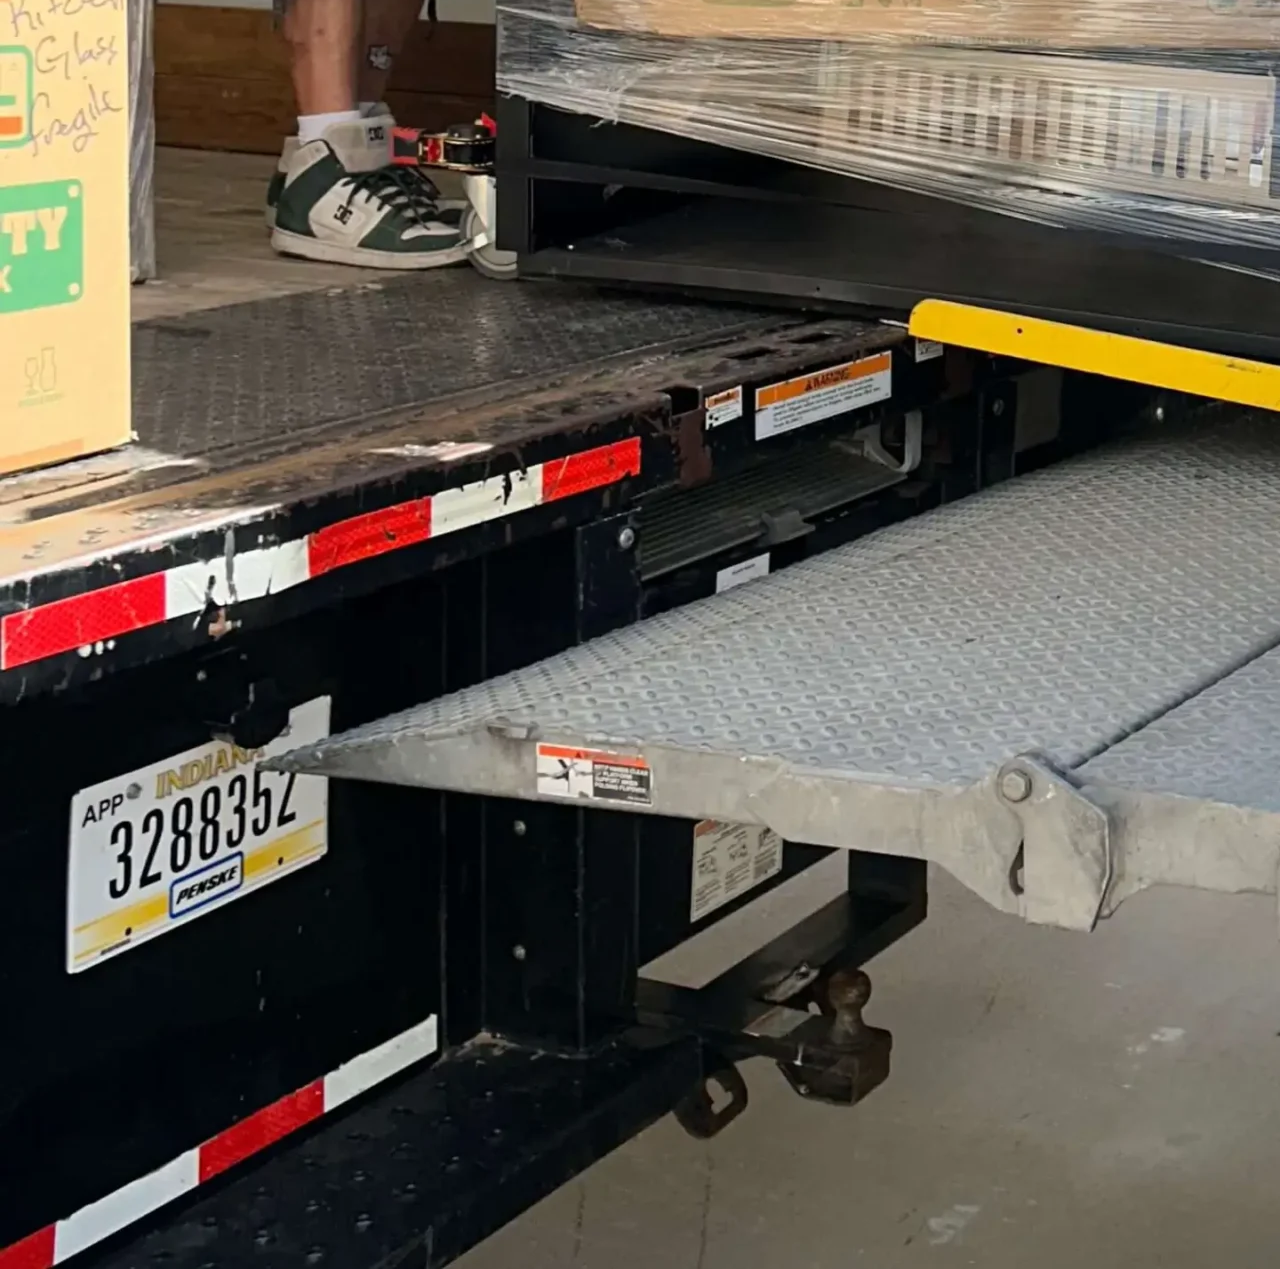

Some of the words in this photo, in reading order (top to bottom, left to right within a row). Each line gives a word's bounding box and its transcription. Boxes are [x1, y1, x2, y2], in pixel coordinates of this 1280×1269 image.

[35, 31, 118, 81] Glass
[82, 794, 124, 828] APP
[108, 770, 297, 900] 3288352
[176, 864, 239, 905] PENSKE
